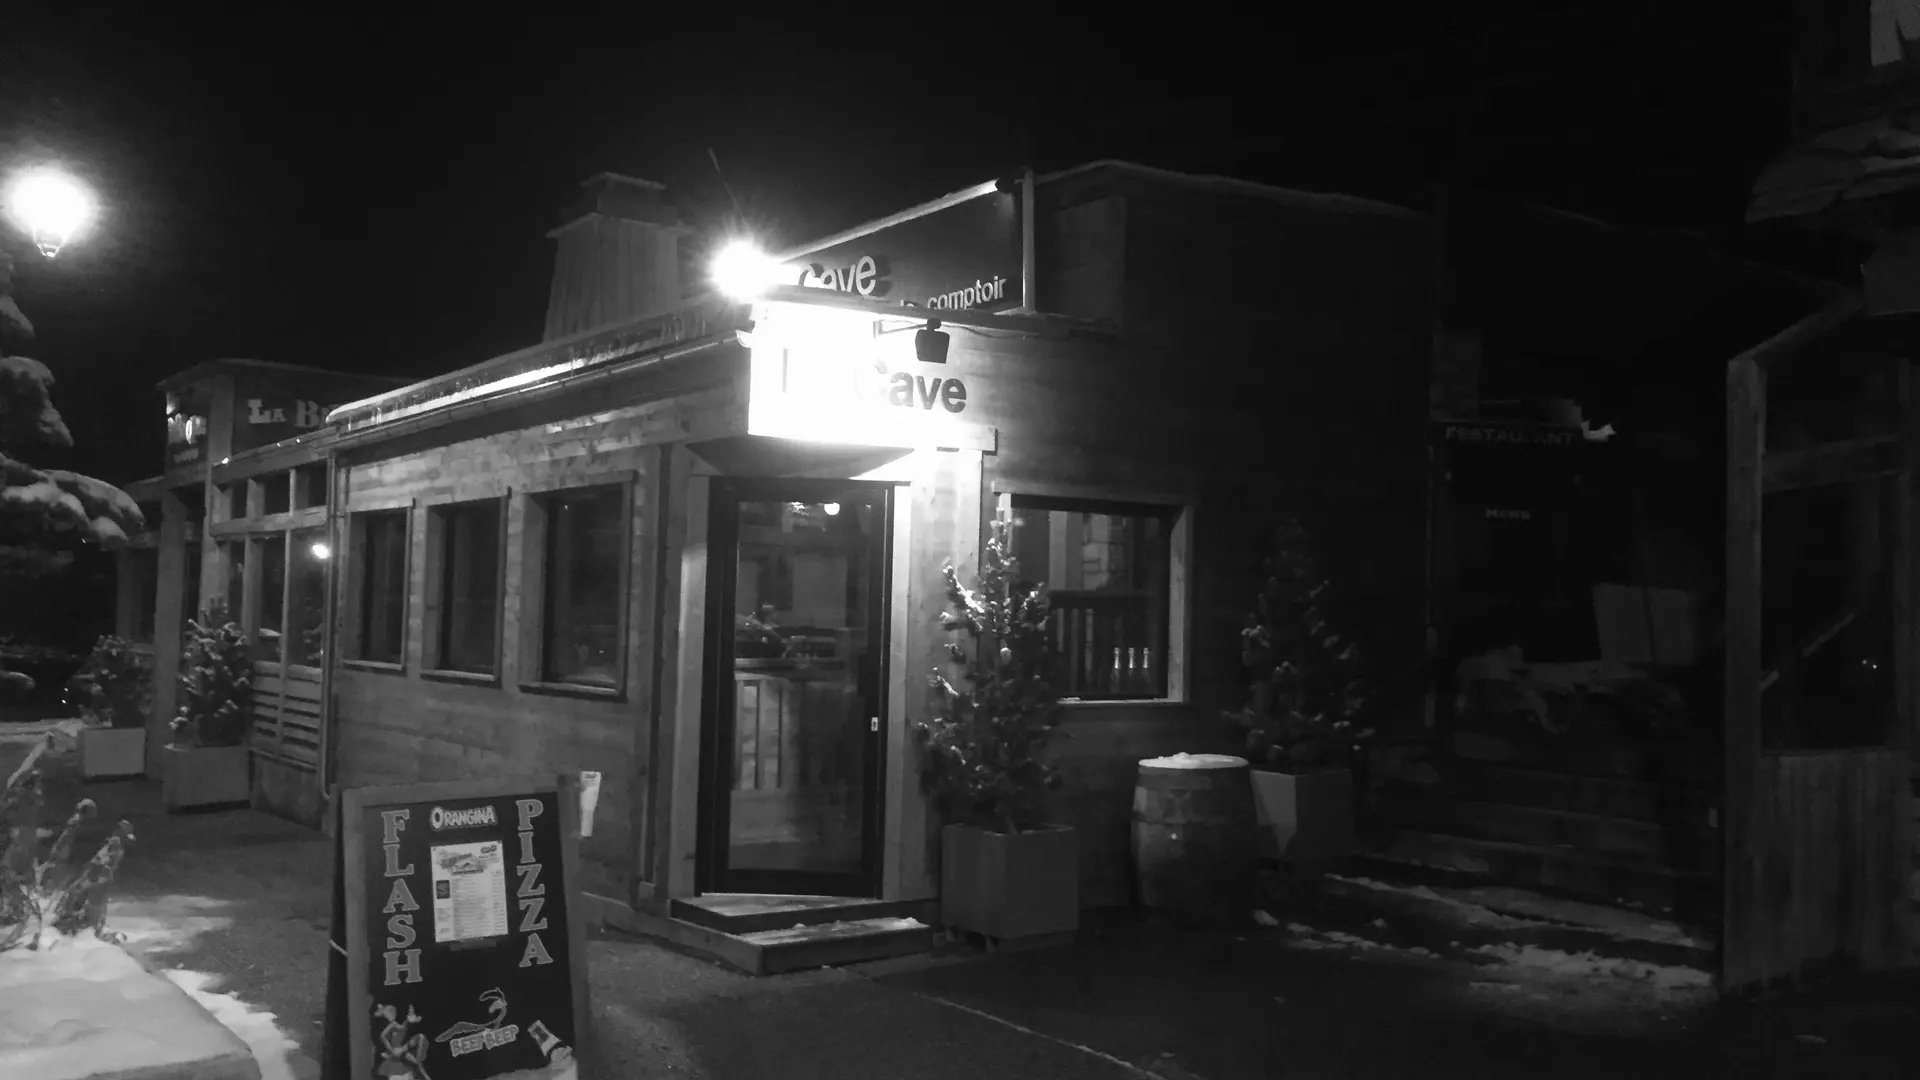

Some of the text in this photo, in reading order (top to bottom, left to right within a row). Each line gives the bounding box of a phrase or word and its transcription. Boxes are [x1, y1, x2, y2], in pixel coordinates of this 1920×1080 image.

[927, 275, 1008, 311] comptoir
[432, 805, 497, 830] ORANGINA
[380, 808, 424, 986] FLASH
[515, 798, 554, 969] PIZZA
